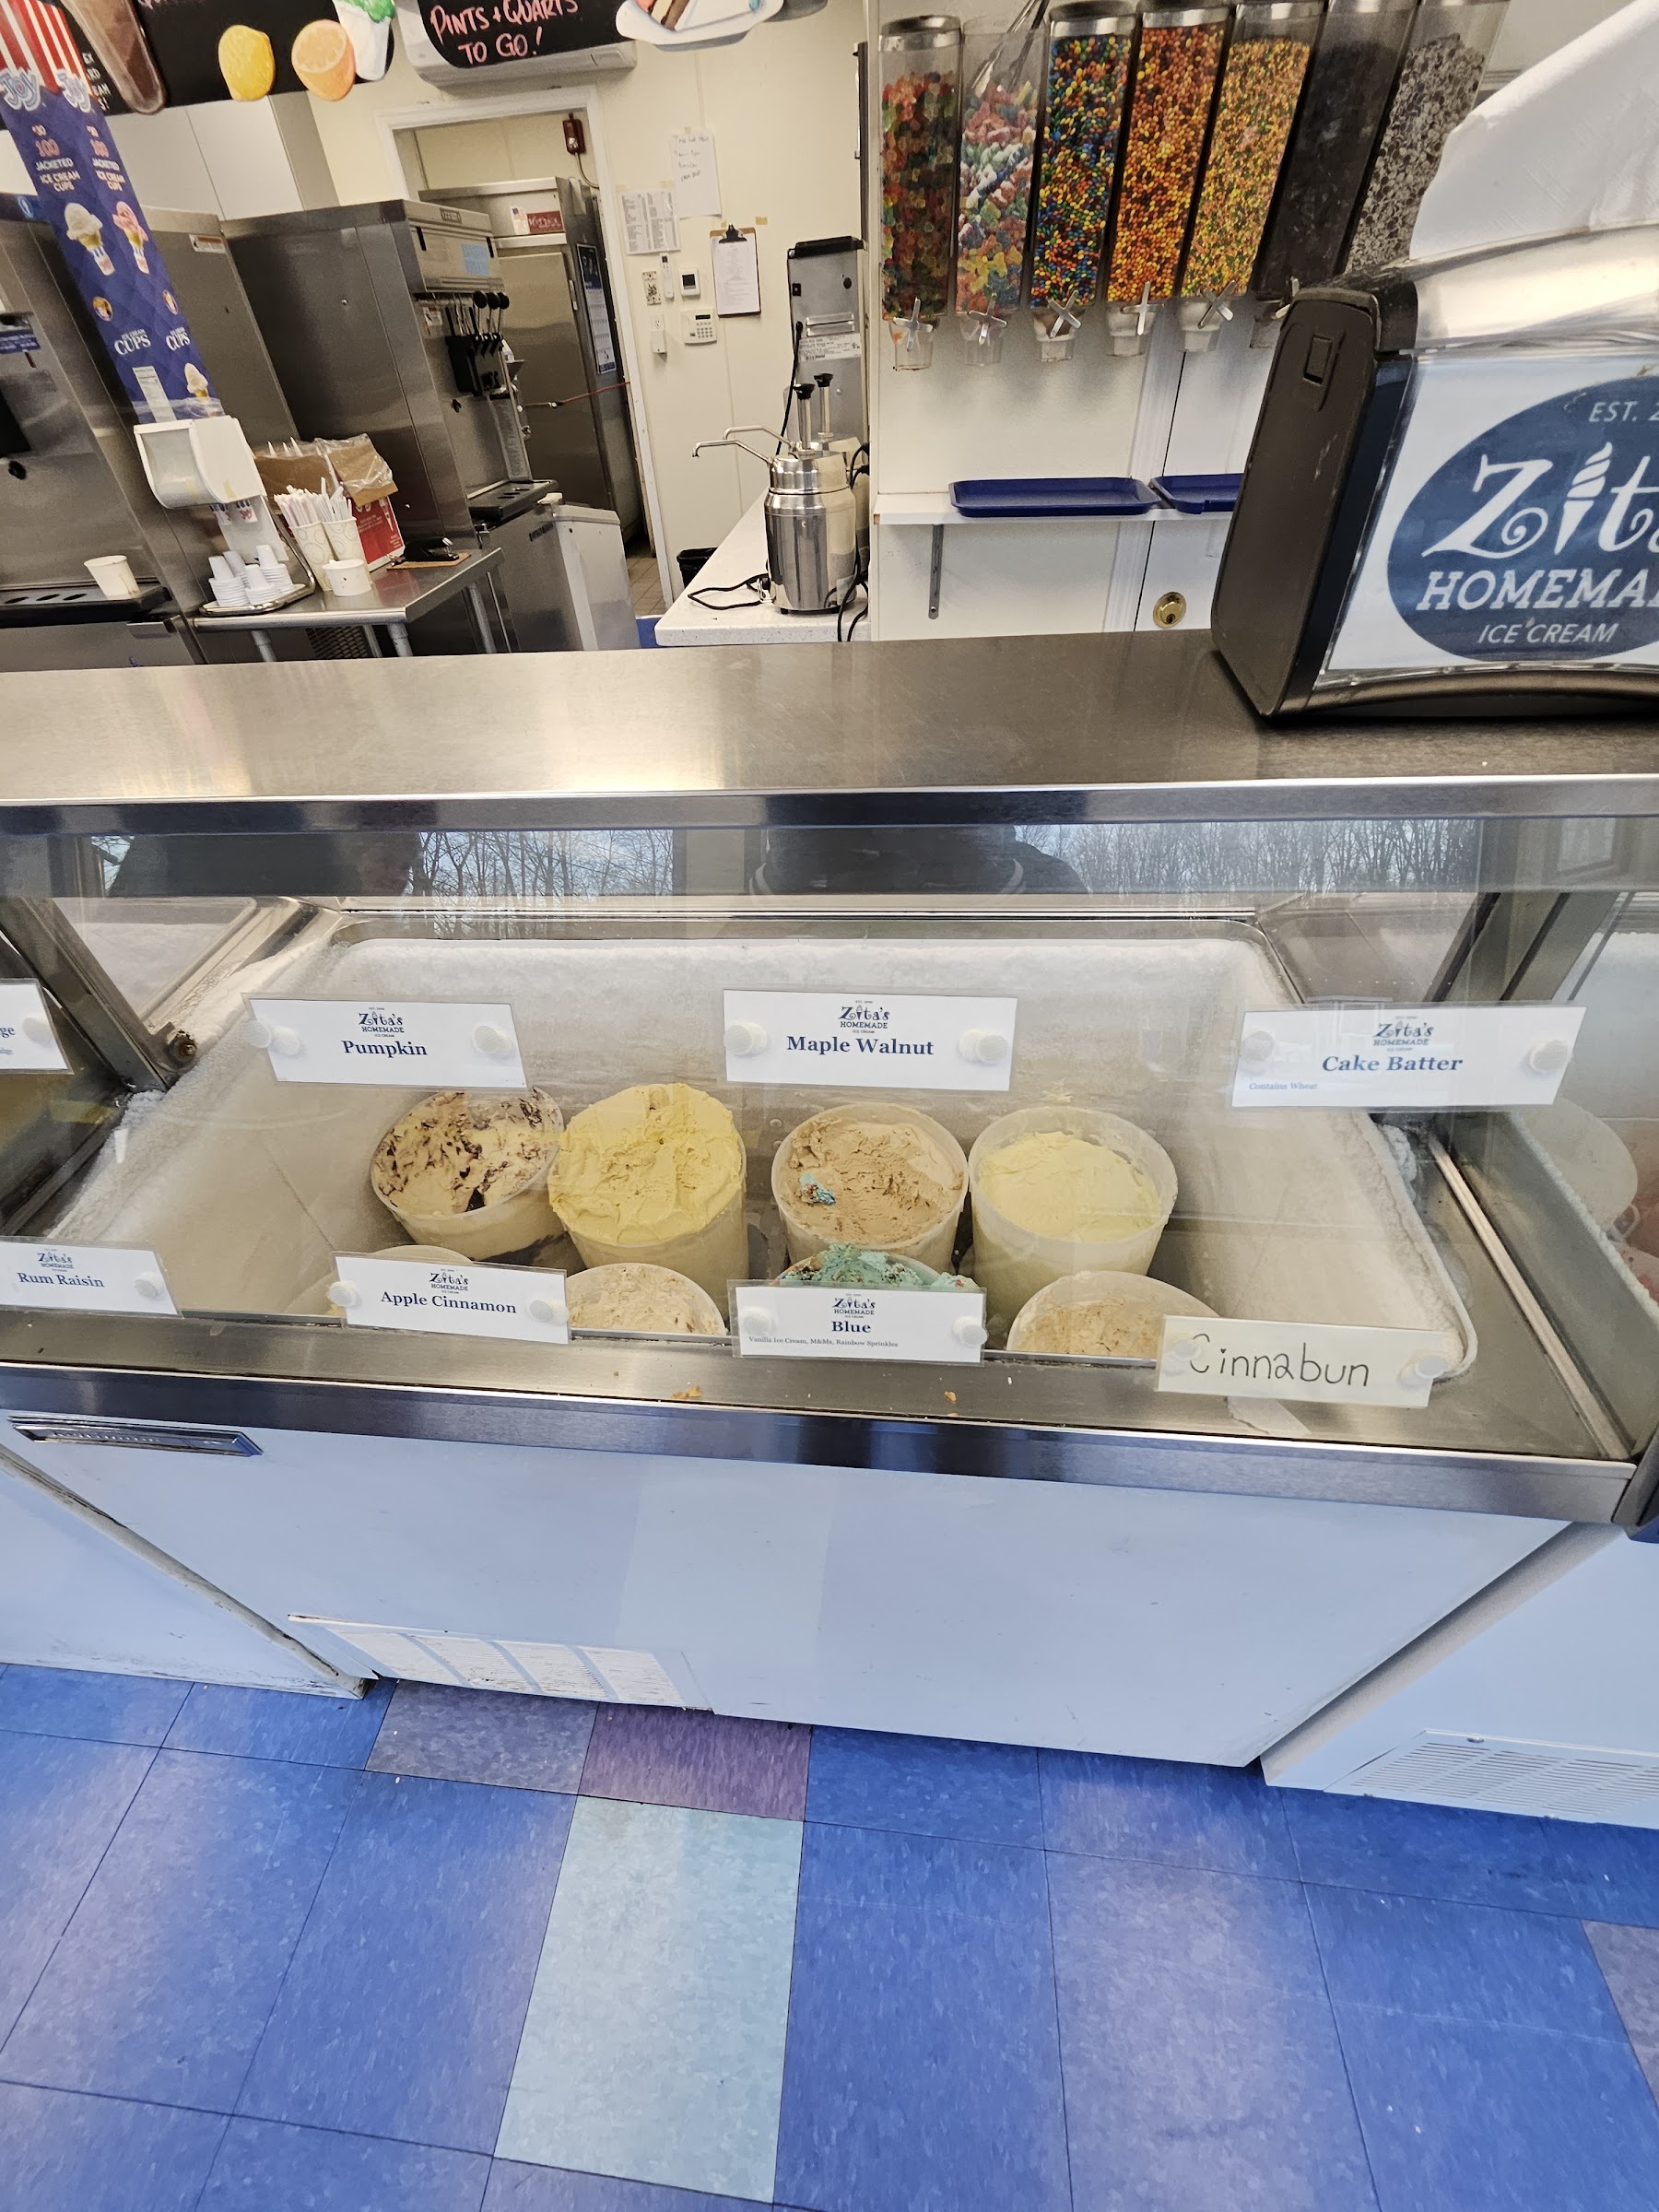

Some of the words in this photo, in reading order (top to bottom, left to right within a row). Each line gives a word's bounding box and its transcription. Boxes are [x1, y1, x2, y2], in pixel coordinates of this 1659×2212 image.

[429, 5, 489, 45] PINTS
[493, 6, 502, 22] +
[502, 0, 579, 25] QUARTS
[457, 41, 488, 65] TO
[495, 26, 543, 57] GO!
[35, 138, 60, 157] 100
[36, 157, 75, 171] JACKETED
[40, 172, 53, 184] ICE
[53, 170, 81, 183] CREAM
[53, 181, 75, 192] CUPS
[114, 334, 151, 355] CUPS
[166, 331, 191, 351] CUPS
[1588, 401, 1639, 422] EST.
[1477, 624, 1522, 644] ICE
[1526, 623, 1619, 643] CREAM
[358, 1010, 404, 1026] Zita's
[838, 1005, 890, 1020] Zita's
[1372, 1020, 1434, 1038] Zita's
[341, 1040, 428, 1058] Pumpkin
[786, 1036, 851, 1055] Maple
[855, 1038, 935, 1054] Walnut
[1322, 1054, 1380, 1072] Cake
[1386, 1055, 1464, 1072] Batter
[1249, 1082, 1288, 1090] Contains
[1290, 1082, 1318, 1090] Wheat
[17, 1272, 54, 1284] Rum
[55, 1274, 105, 1288] Raisin
[430, 1283, 469, 1291] HOMEMADE
[381, 1290, 428, 1307] Apple
[431, 1295, 517, 1313] Cinnamon
[832, 1297, 877, 1309] Zita's
[831, 1320, 871, 1334] Blue
[866, 1339, 898, 1347] Sprinkles
[1189, 1333, 1370, 1386] Cinnabun
